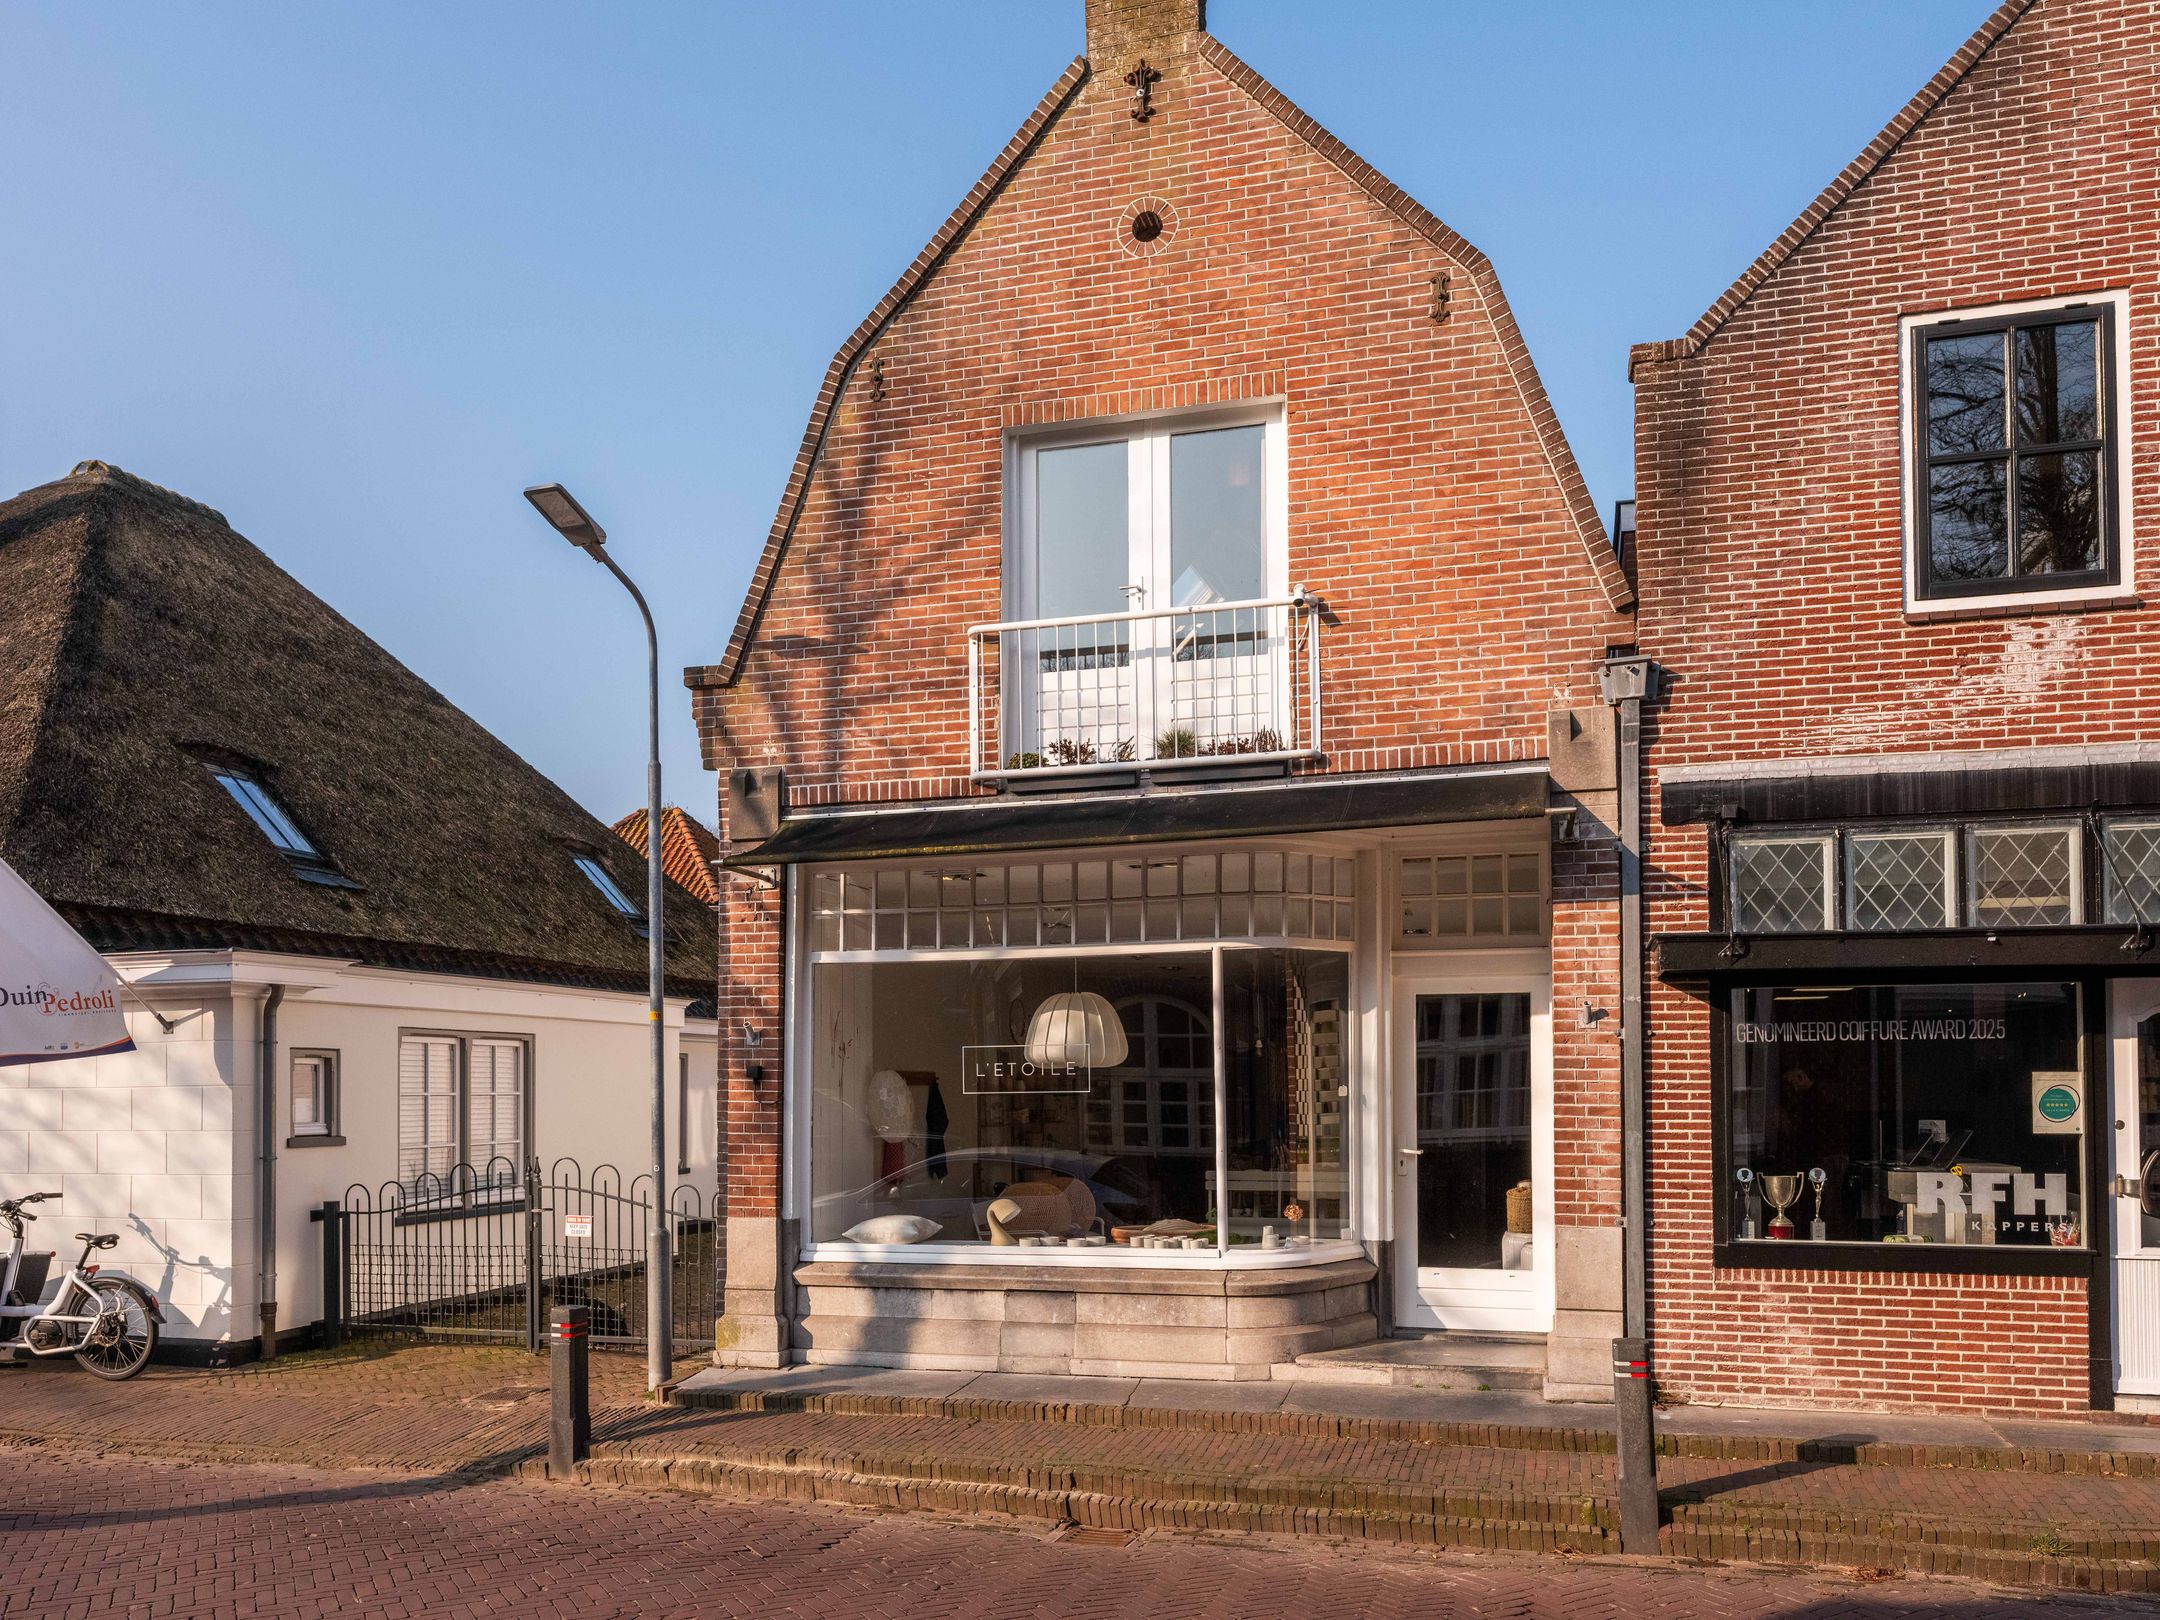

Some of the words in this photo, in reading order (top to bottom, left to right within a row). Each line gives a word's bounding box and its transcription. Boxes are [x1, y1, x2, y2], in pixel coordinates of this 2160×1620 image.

[43, 989, 116, 1013] Pedroli
[1736, 1021, 1836, 1043] GENOMINEERD
[1839, 1020, 1908, 1041] COIFFURE
[1911, 1019, 1966, 1040] AWARD
[1969, 1019, 2006, 1040] 2025
[976, 1061, 1076, 1077] L'ETOILE
[1917, 1172, 2067, 1215] RFH
[1971, 1221, 2067, 1232] KAPPERS
